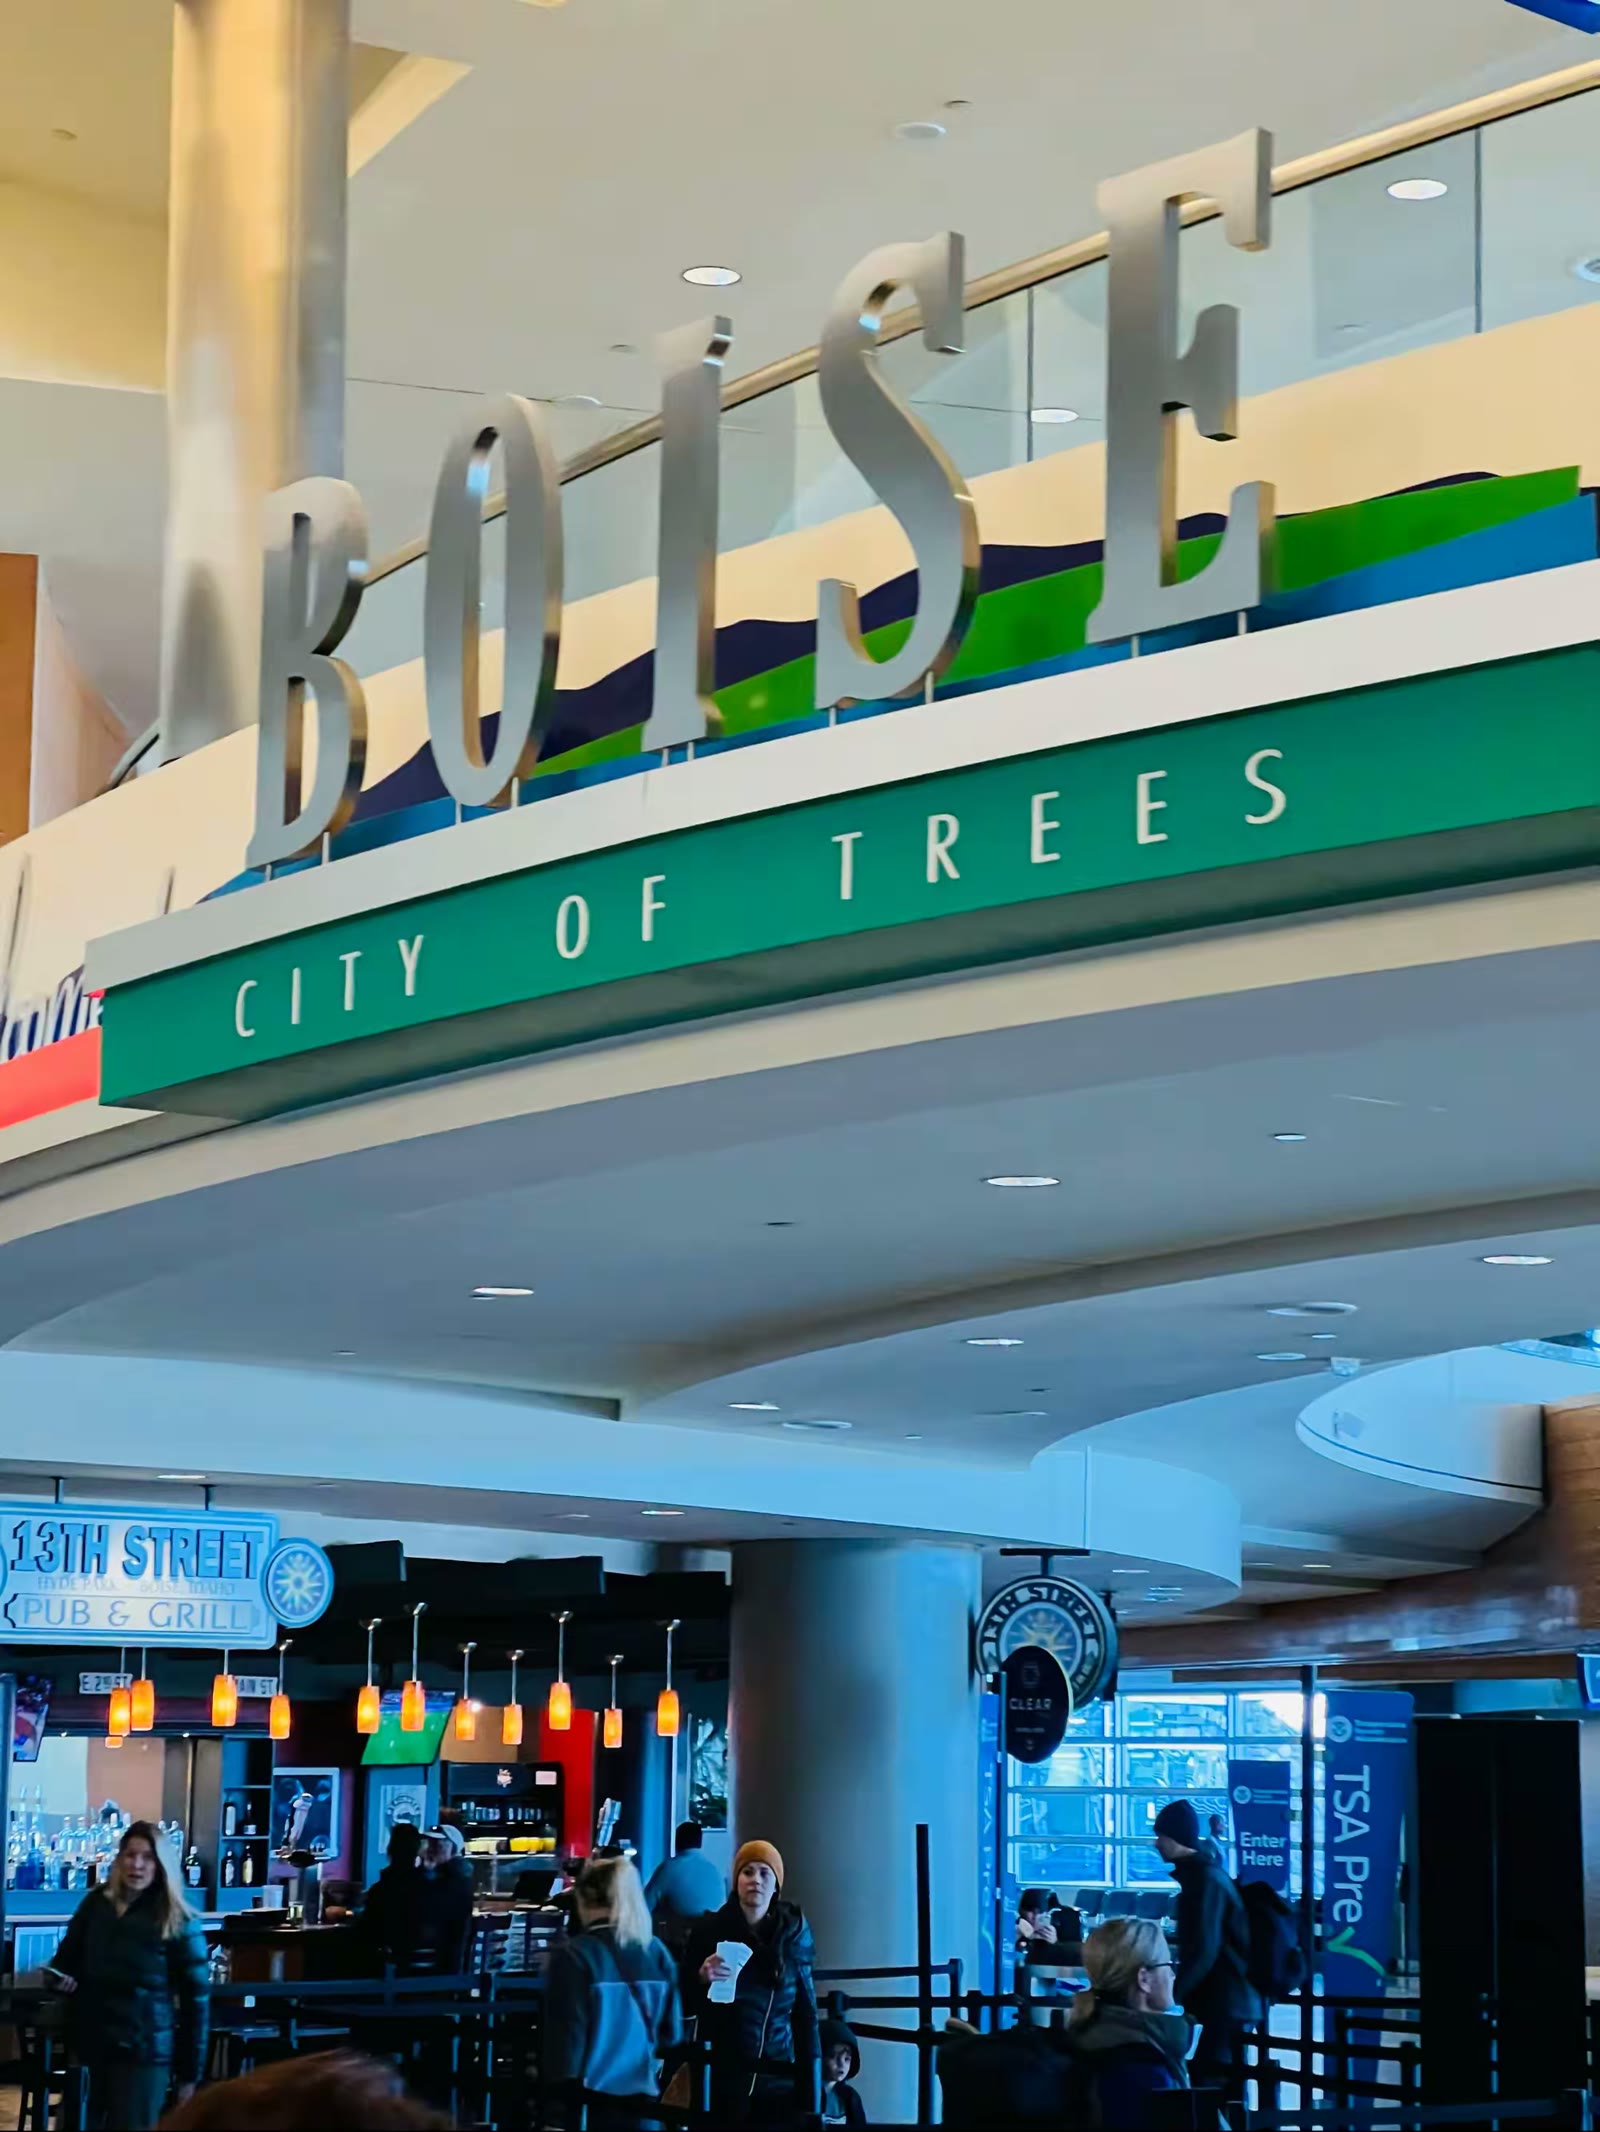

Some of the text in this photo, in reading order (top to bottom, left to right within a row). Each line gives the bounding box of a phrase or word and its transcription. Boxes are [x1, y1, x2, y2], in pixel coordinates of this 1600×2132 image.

[247, 127, 1273, 869] BOISE
[235, 748, 1287, 1037] CITY OF TREES
[11, 1520, 264, 1580] 13TH STREET
[24, 1599, 248, 1630] PUB & GRILL
[236, 1678, 256, 1695] AIN
[1009, 1697, 1051, 1711] CLEAR
[1240, 1831, 1287, 1849] Enter
[1333, 1765, 1371, 1923] TSA Pre
[1242, 1849, 1285, 1867] Here
